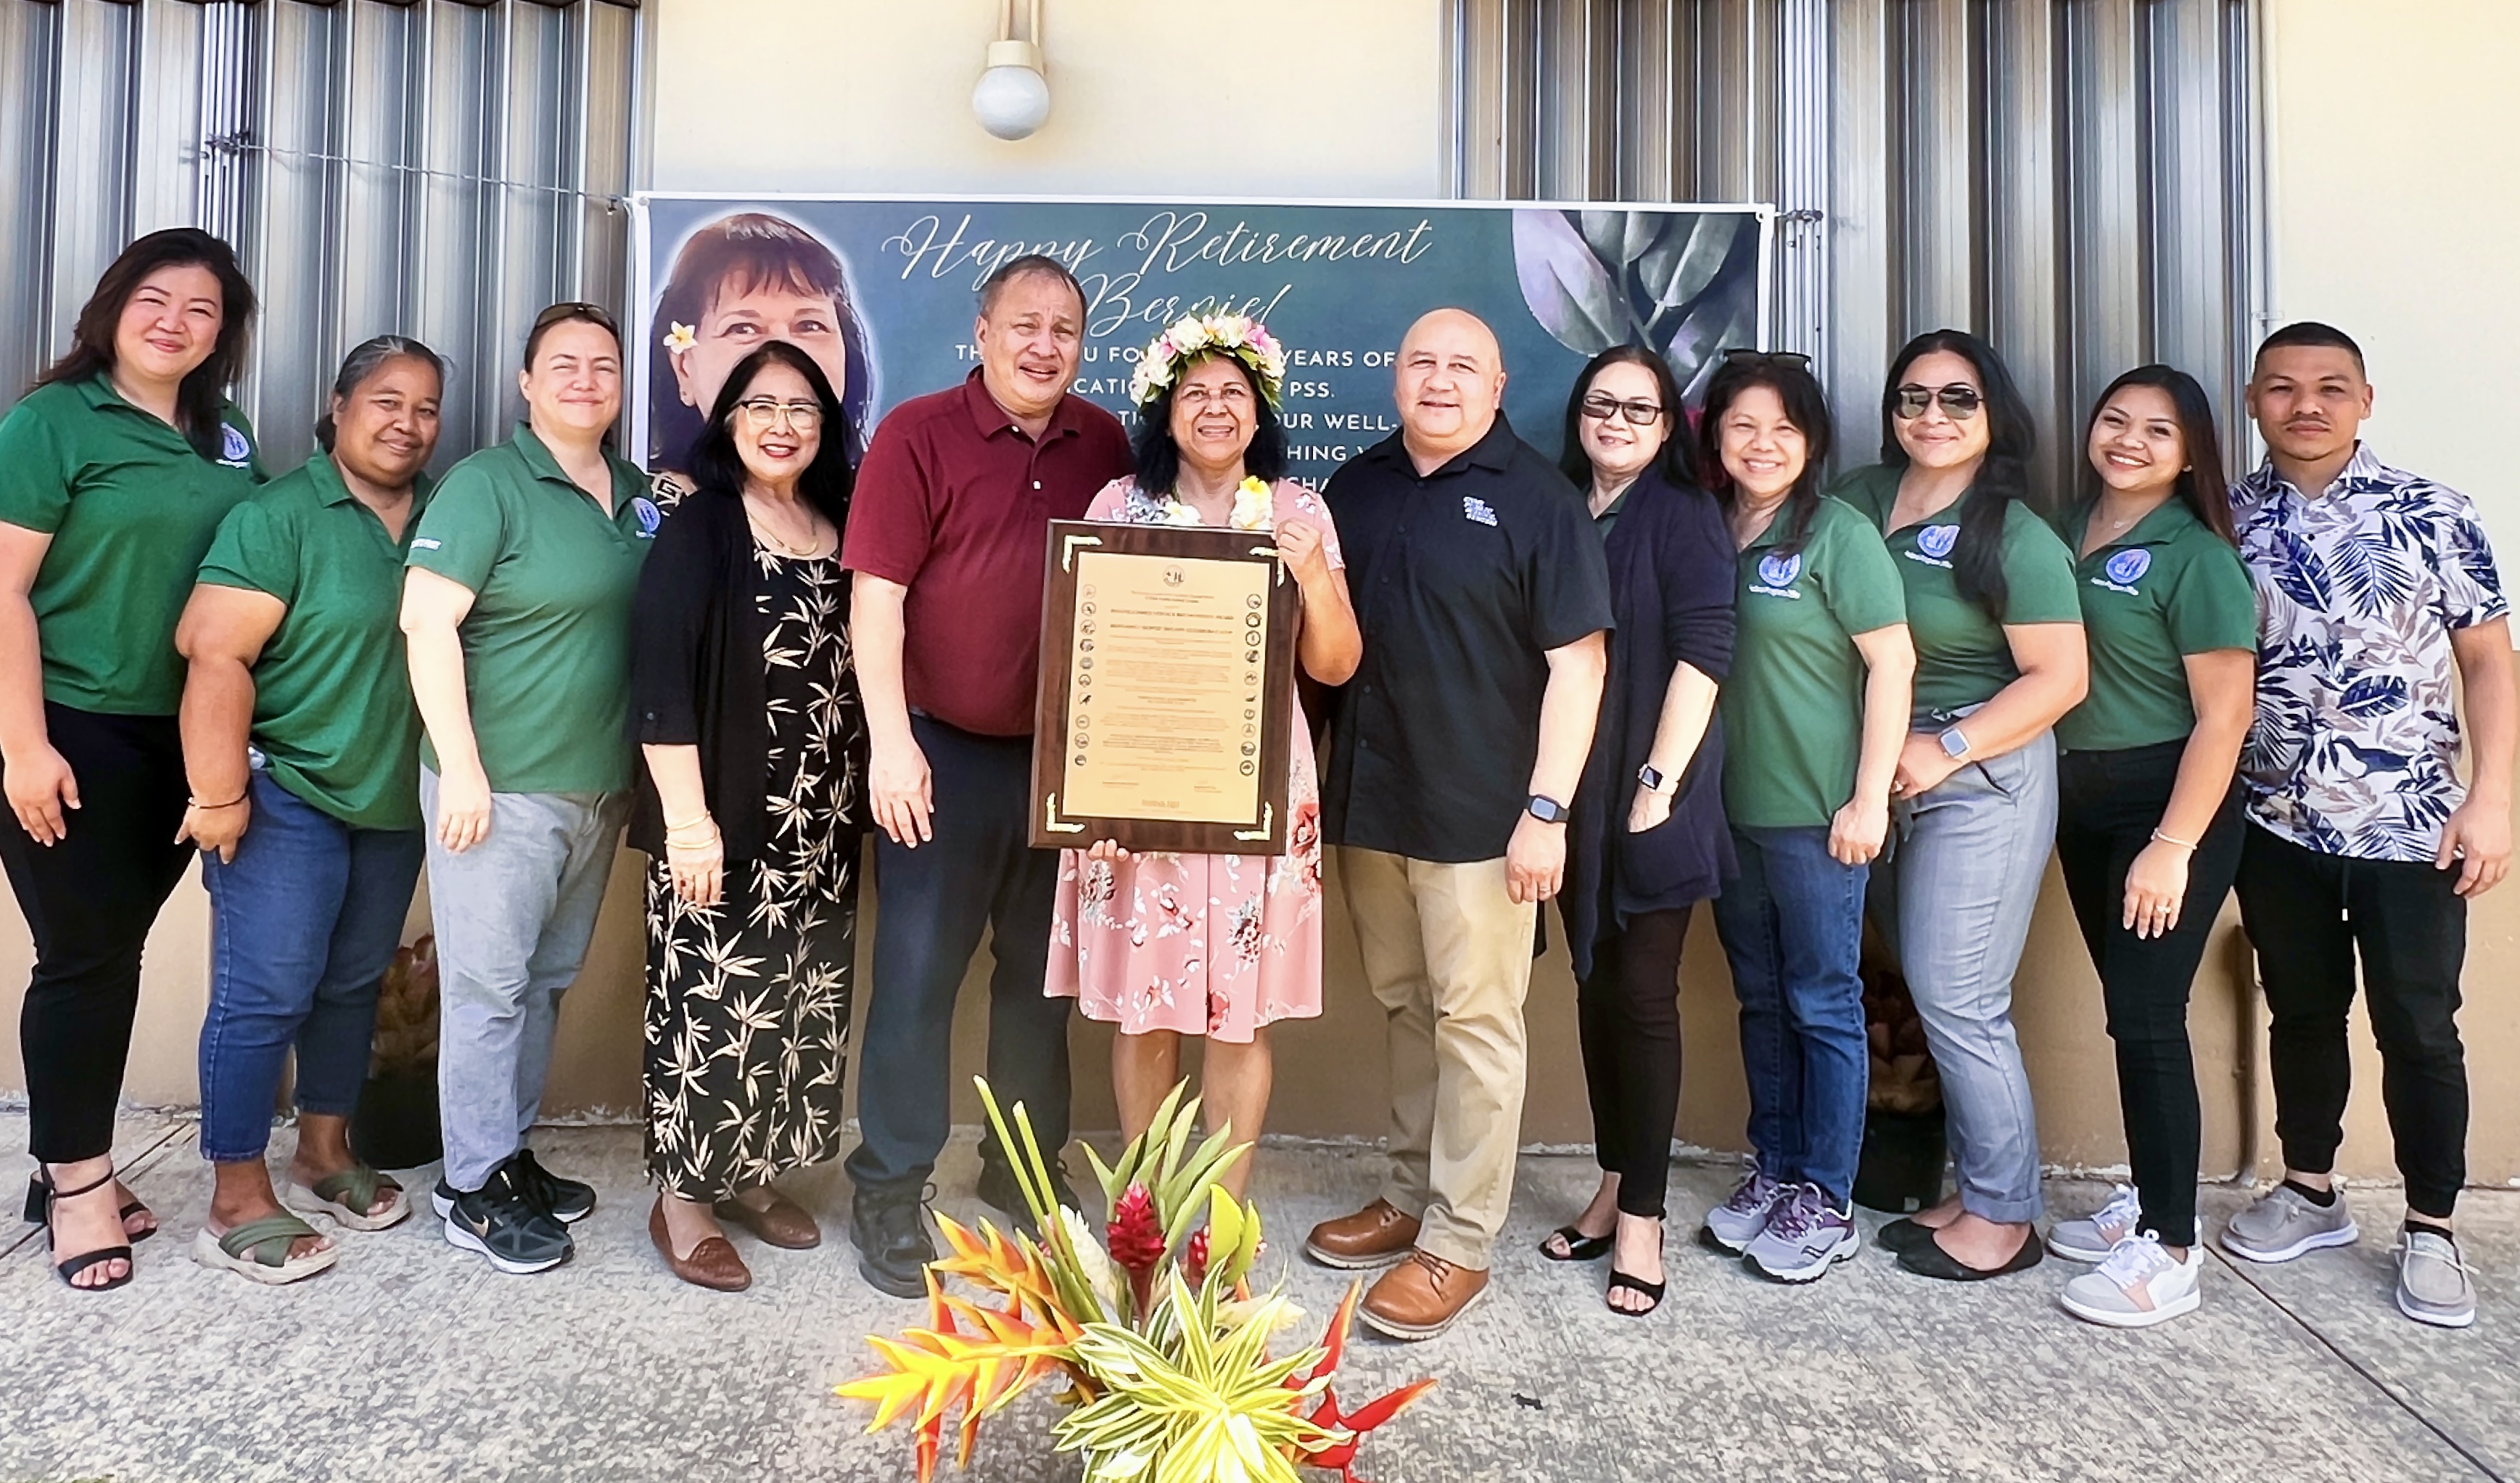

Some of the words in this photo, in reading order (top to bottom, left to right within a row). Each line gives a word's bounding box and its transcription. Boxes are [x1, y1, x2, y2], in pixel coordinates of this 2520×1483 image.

[881, 214, 1104, 292] Happy
[1116, 211, 1433, 275] Retirement
[1108, 346, 1140, 363] FO
[1282, 349, 1353, 366] YEARS
[1363, 351, 1396, 367] OF
[1290, 381, 1335, 398] PSS.
[1324, 414, 1398, 431] WELL-
